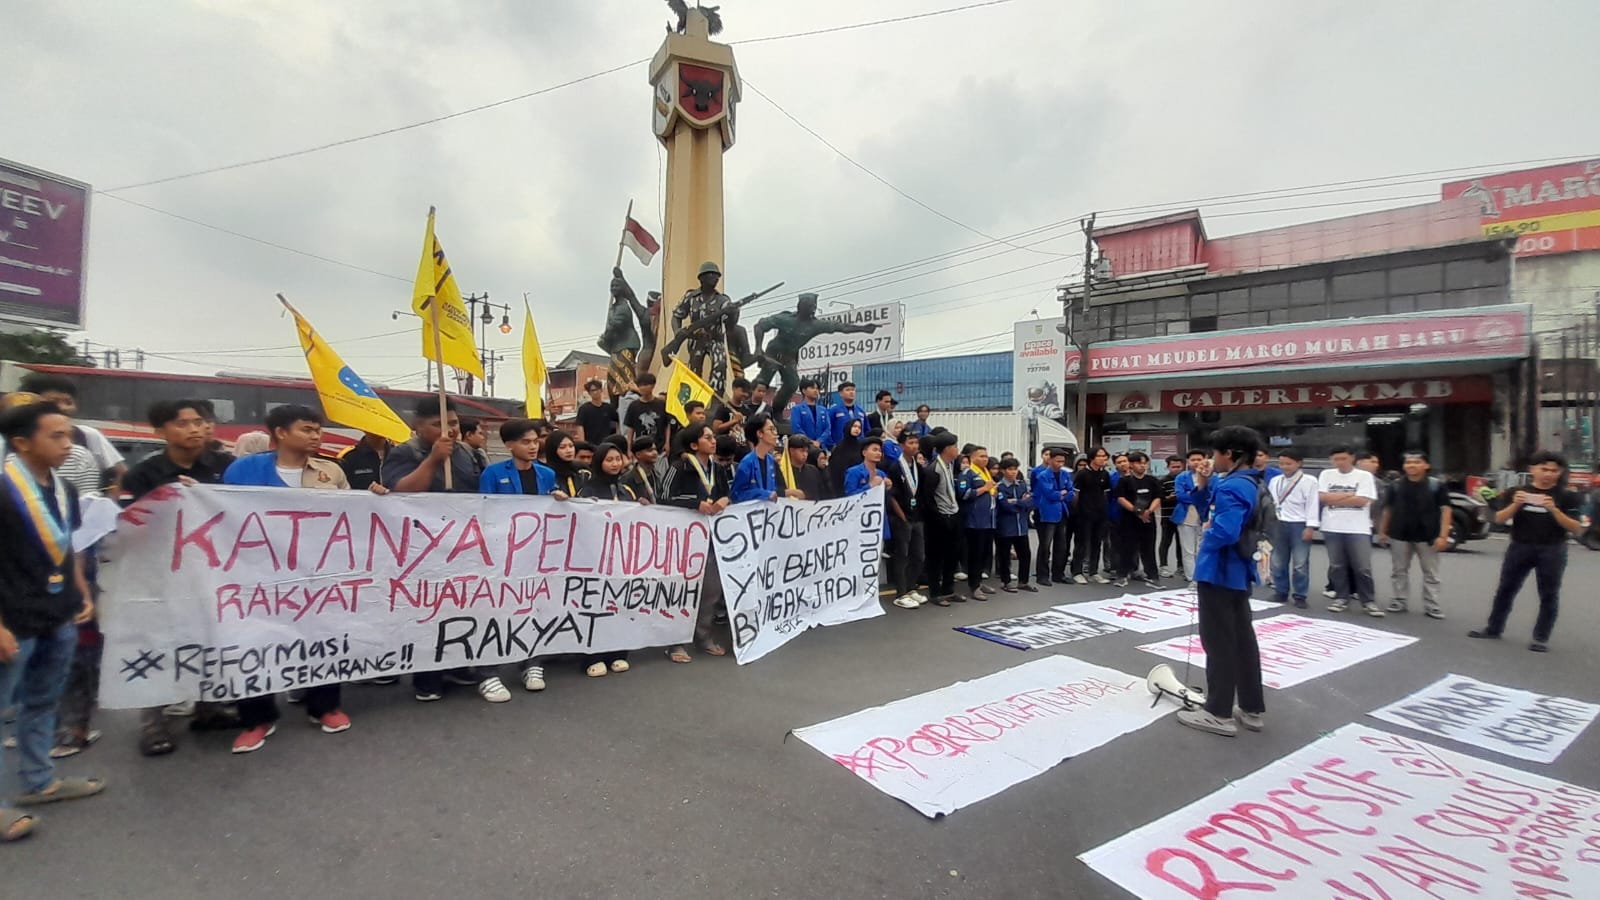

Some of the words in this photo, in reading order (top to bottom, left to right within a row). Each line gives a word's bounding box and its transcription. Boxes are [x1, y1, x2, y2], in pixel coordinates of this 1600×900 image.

[0, 188, 66, 219] EEV
[800, 336, 892, 360] 08112954977
[1091, 354, 1141, 370] PUSAT
[1147, 348, 1219, 366] MEUBEL
[1225, 342, 1297, 361] MARGO
[1304, 335, 1390, 355] MURAH
[171, 508, 494, 581] KATANYA
[783, 538, 848, 584] BENER
[216, 578, 374, 622] RAKYAT
[563, 576, 700, 610] PEMBUNUH
[811, 576, 857, 609] JADI
[434, 611, 617, 663] RAKYAT
[1387, 682, 1512, 736] APARAT
[1145, 757, 1415, 900] REPRESIF
[1413, 770, 1556, 853] SOLUSI
